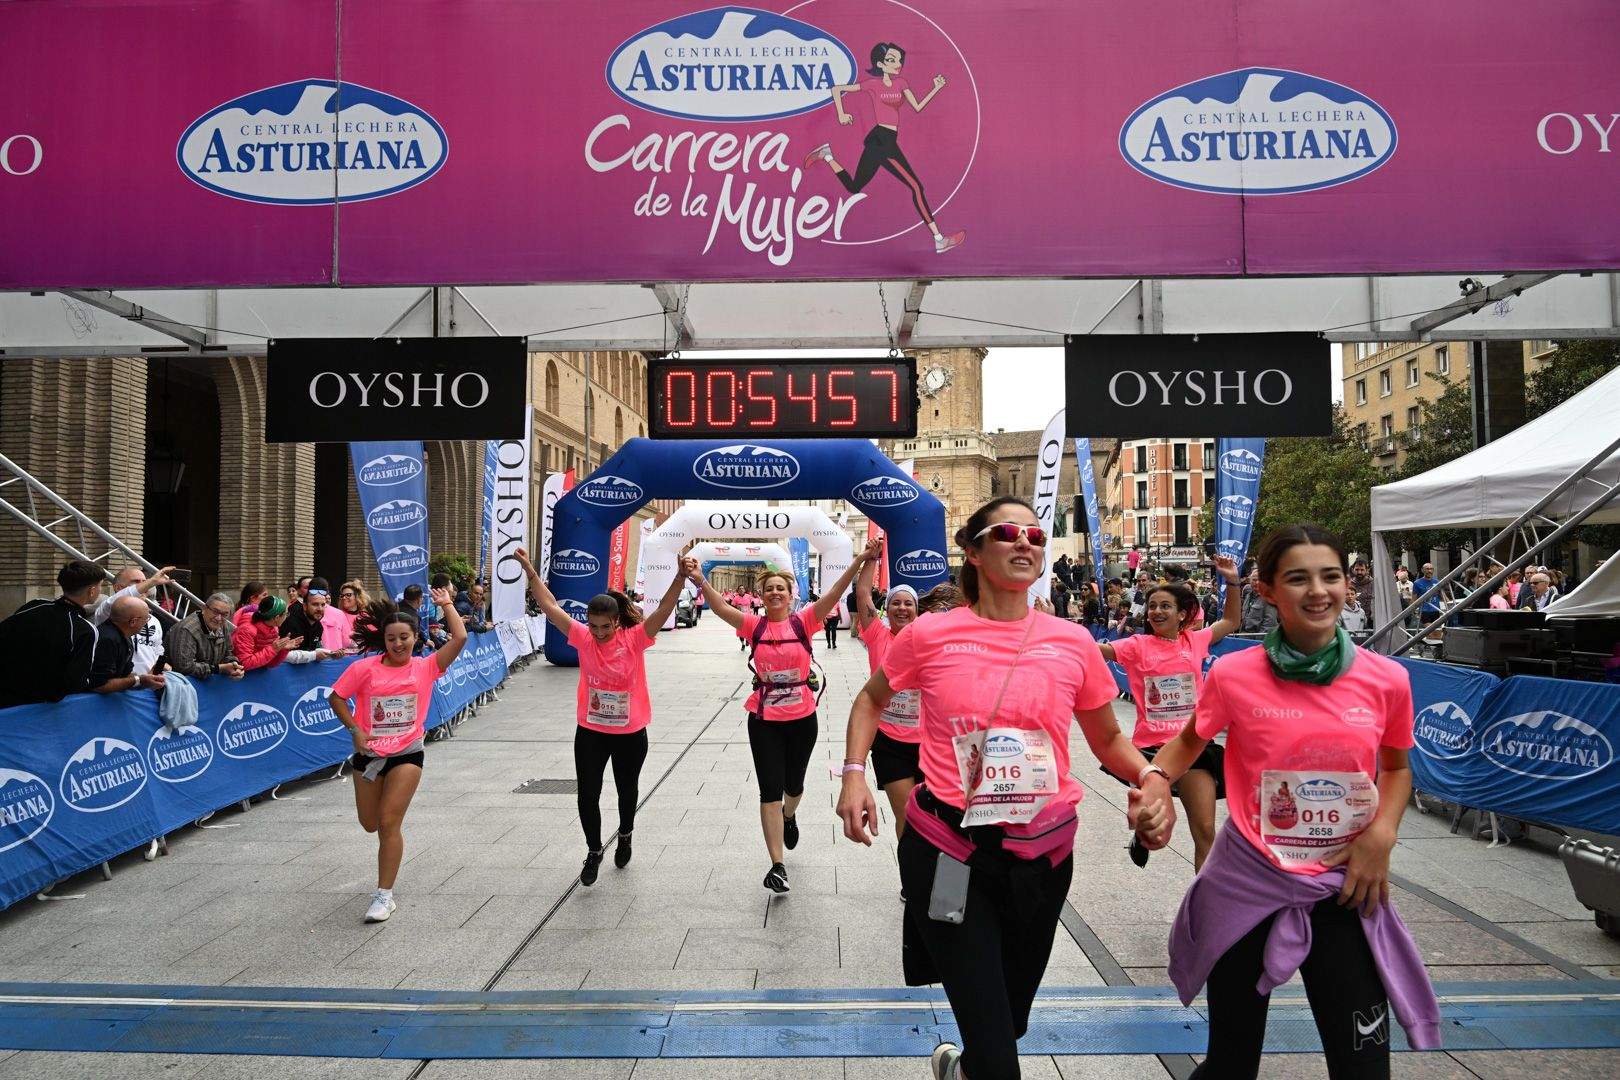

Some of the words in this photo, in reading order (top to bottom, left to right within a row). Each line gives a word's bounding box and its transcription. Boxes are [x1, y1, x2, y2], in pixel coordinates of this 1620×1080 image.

[664, 47, 743, 58] CENTRAL
[751, 46, 830, 57] LECHERA
[625, 50, 837, 92] ASTURIANA
[1183, 112, 1270, 124] CENTRAL
[1278, 110, 1367, 122] LECHERA
[240, 123, 324, 136] CENTRAL
[331, 121, 419, 134] LECHERA
[1536, 112, 1620, 155] OY
[584, 114, 795, 174] Carrera
[1141, 116, 1377, 163] ASTURIANA
[197, 128, 427, 174] ASTURIANA
[634, 176, 672, 217] de
[681, 177, 709, 217] la
[702, 168, 867, 266] Mujer
[308, 371, 490, 408] OYSHO
[1108, 368, 1293, 407] OYSHO
[701, 458, 792, 477] ASTURIANA
[1035, 439, 1060, 520] SHO
[580, 487, 638, 499] ASTURIANA
[857, 489, 915, 500] ASTURIANA
[496, 440, 525, 585] OYSHO
[708, 513, 790, 529] OYSHO
[944, 643, 988, 653] OYSHO
[1162, 692, 1180, 700] 016
[1252, 706, 1304, 719] OYSHO
[224, 721, 285, 751] ASTURIANA
[153, 743, 211, 772] ASTURIANA
[1488, 731, 1600, 768] ASTURIANA
[78, 763, 109, 777] CENTRAL
[110, 752, 137, 768] LECHERA
[985, 765, 1021, 779] 016
[70, 761, 145, 803] ASTURIANA
[993, 783, 1016, 792] 2657
[1302, 809, 1340, 823] 016
[1274, 837, 1307, 845] CARRERA
[1308, 828, 1333, 836] 2658
[1280, 851, 1309, 860] YSHO
